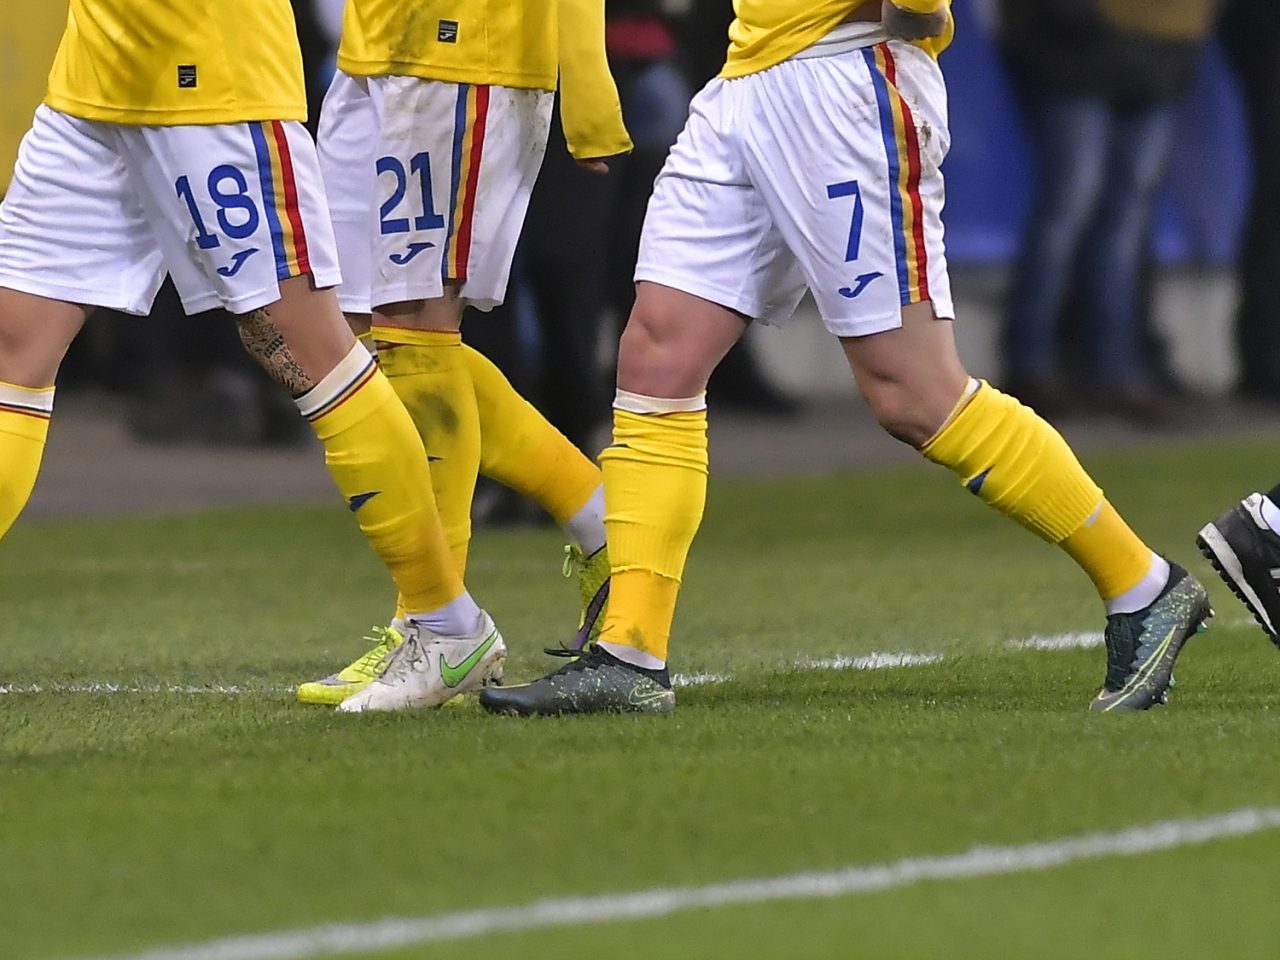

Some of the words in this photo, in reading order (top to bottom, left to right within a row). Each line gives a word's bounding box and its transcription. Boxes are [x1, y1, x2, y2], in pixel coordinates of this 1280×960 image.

[175, 164, 259, 249] 18
[376, 152, 445, 235] 21
[826, 180, 864, 262] 7
